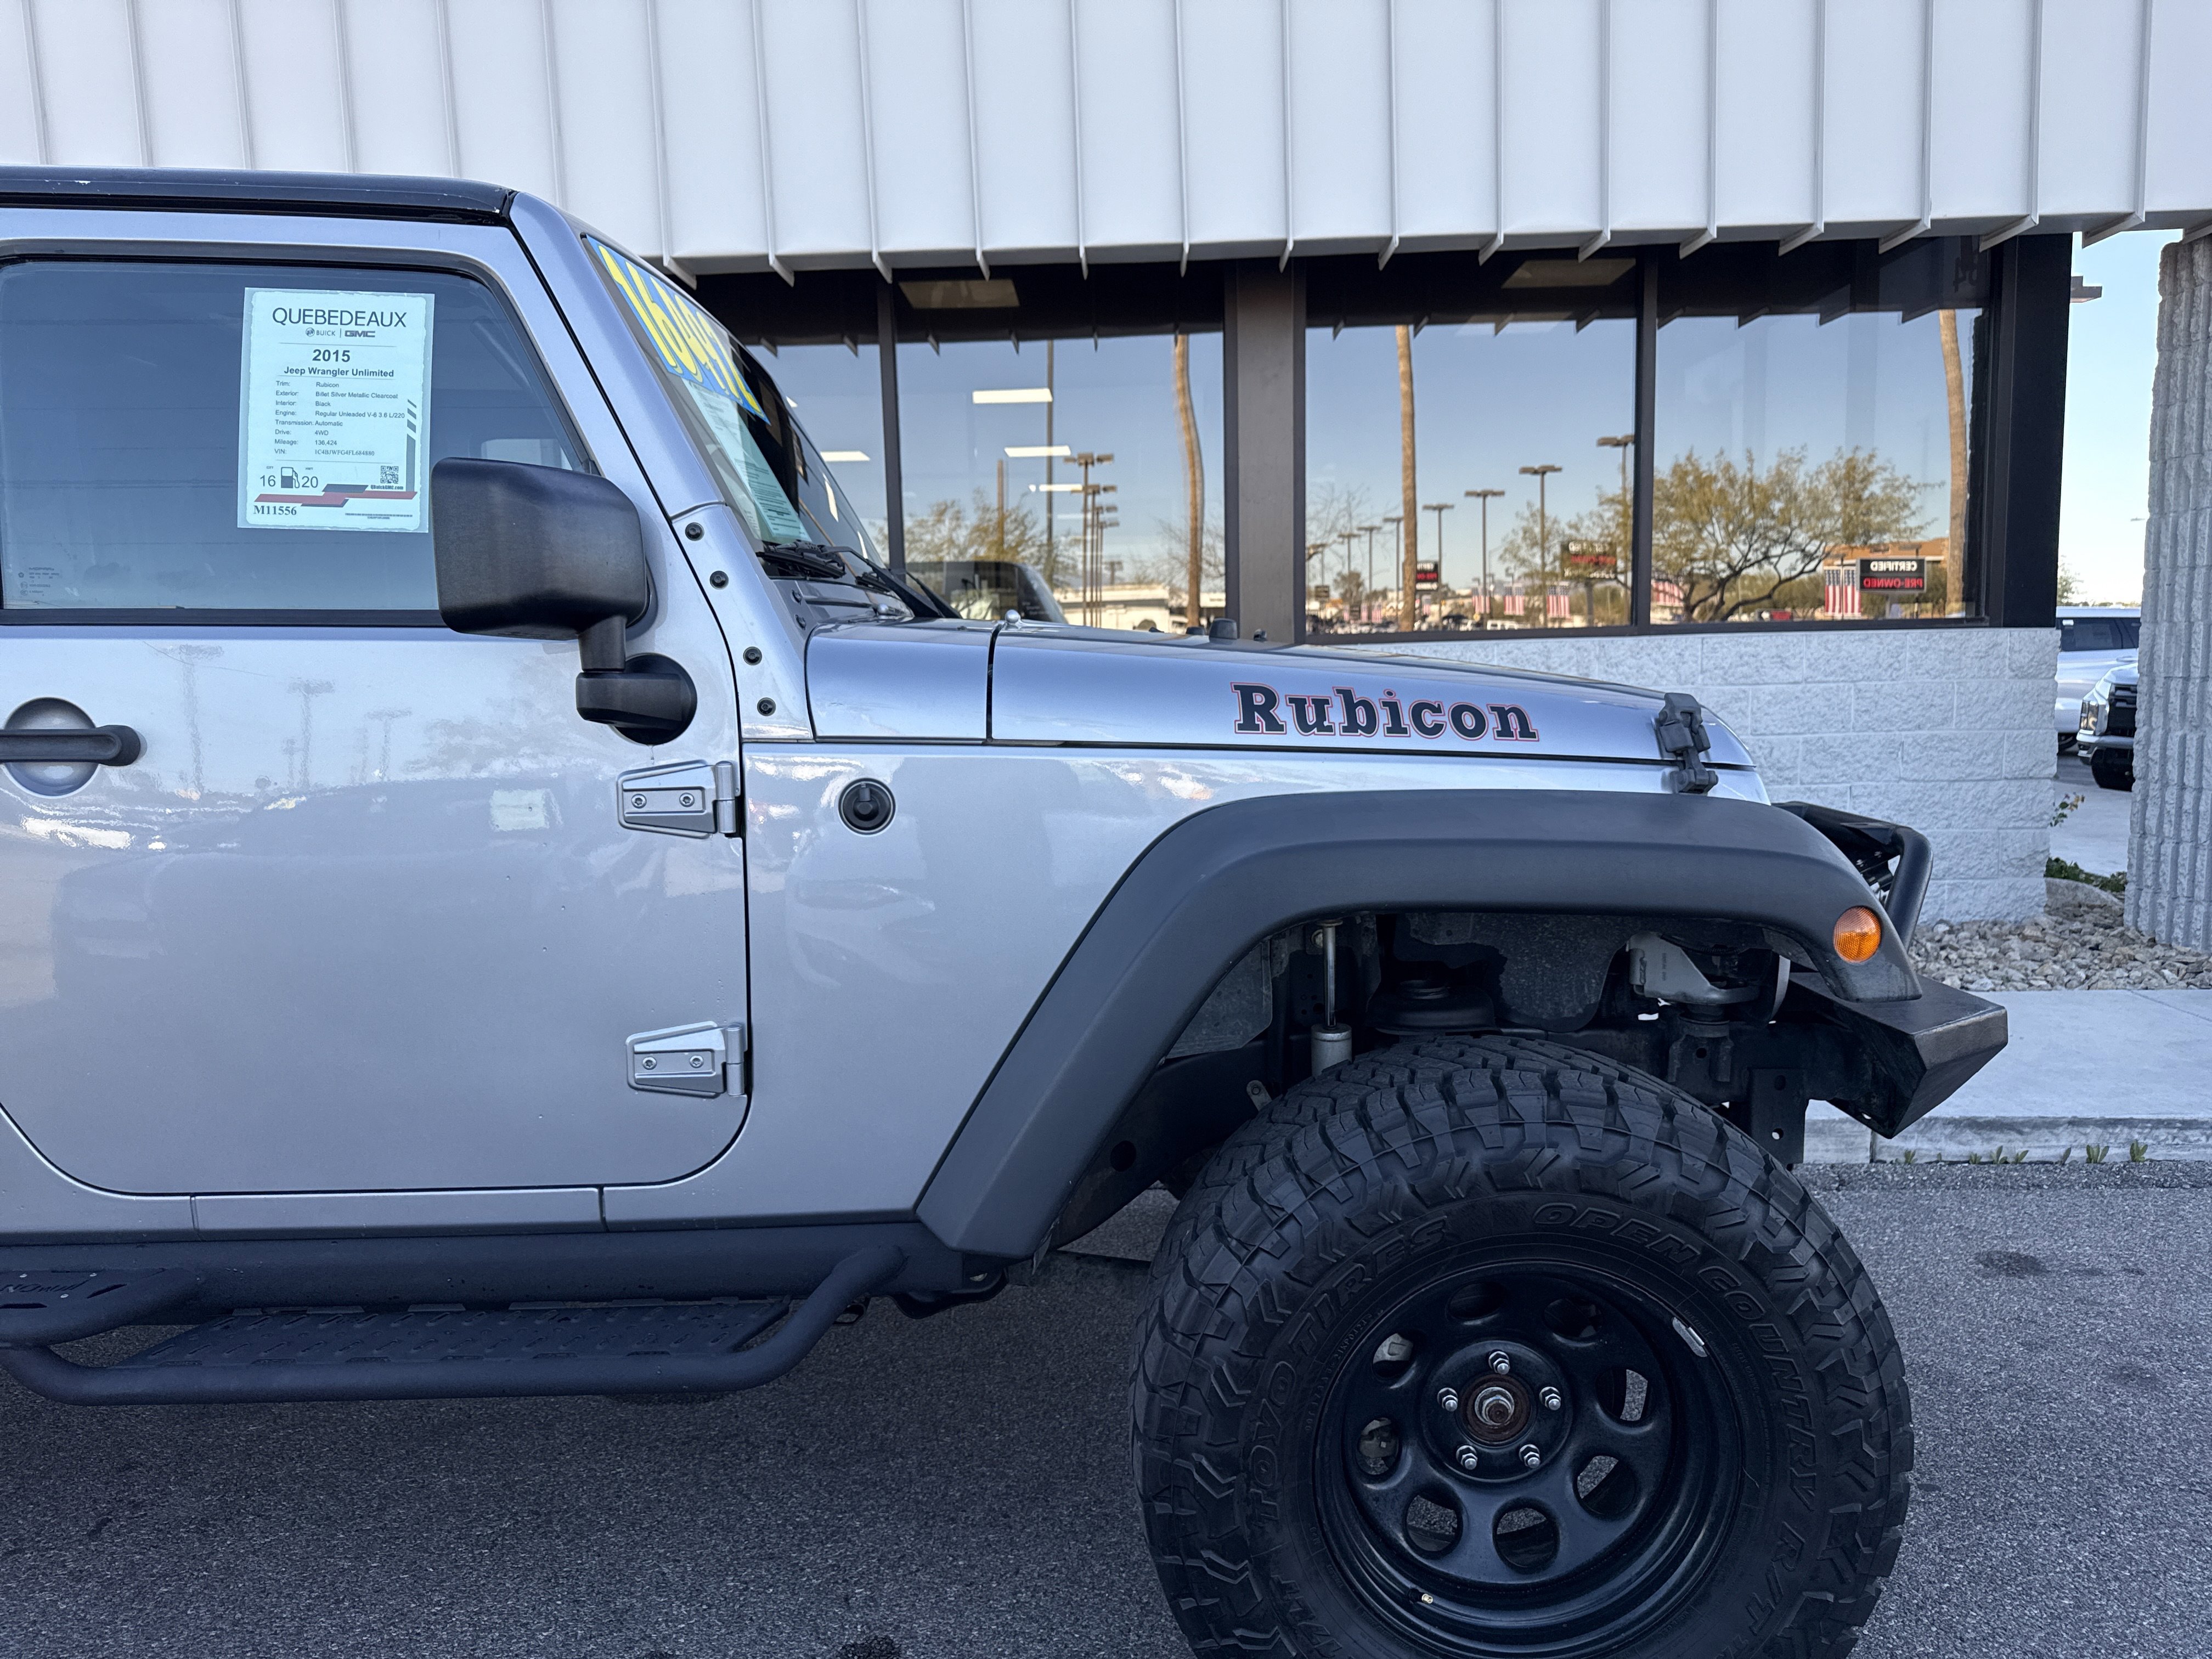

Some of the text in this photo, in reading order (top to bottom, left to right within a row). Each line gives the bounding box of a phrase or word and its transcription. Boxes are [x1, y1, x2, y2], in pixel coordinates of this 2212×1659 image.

[272, 307, 407, 328] QUEBEDEAUX
[312, 349, 351, 363] 2015
[284, 366, 394, 377] Jeep Wrangler Unlimited
[260, 475, 318, 488] 16 20
[253, 505, 297, 515] M11556
[1230, 682, 1539, 742] Rubicon
[1289, 1215, 1450, 1353] TIRES
[1534, 1203, 1700, 1265] OPEN
[1697, 1264, 1818, 1513] COUNTRY
